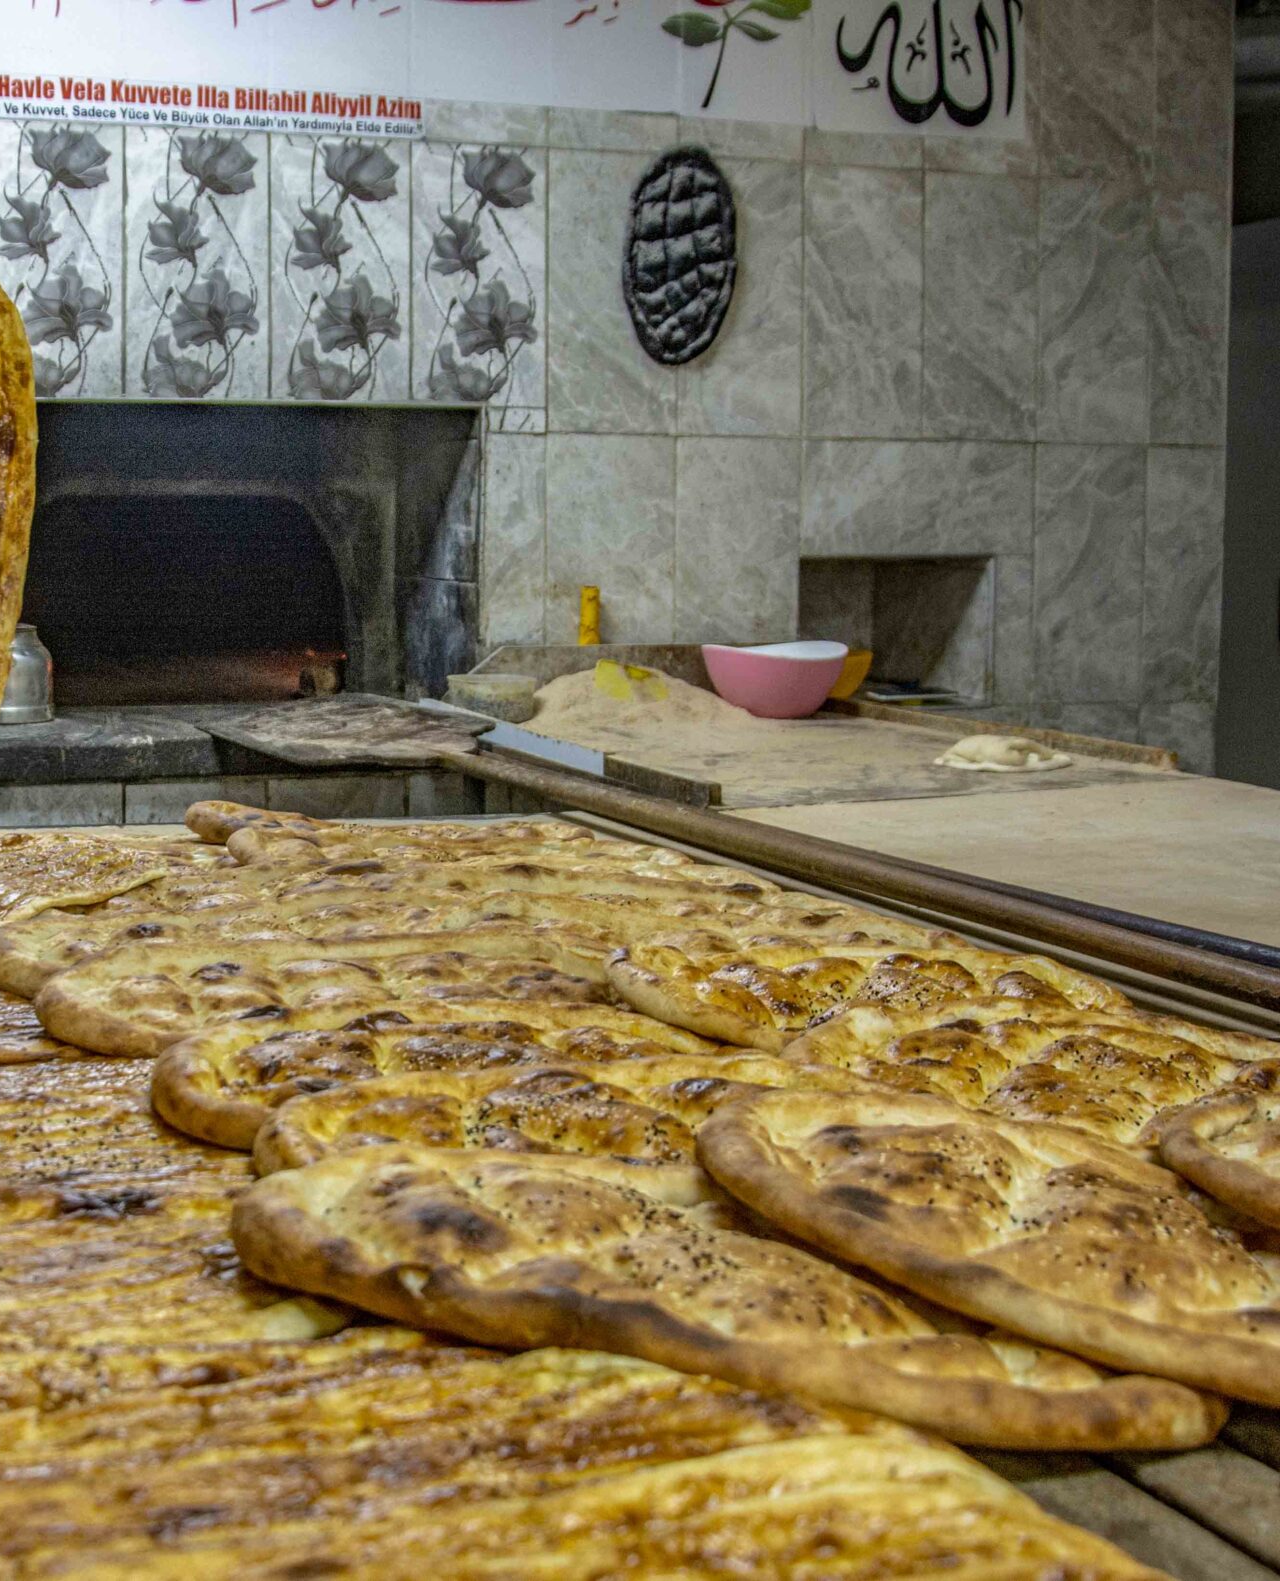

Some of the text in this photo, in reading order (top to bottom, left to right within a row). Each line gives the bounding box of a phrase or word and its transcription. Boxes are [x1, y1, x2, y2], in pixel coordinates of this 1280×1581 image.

[59, 77, 106, 101] Vela
[111, 80, 192, 106] Kuvvete
[234, 87, 307, 113] Billahil
[311, 91, 372, 118] Aliyyil
[376, 95, 422, 119] Azim
[4, 102, 19, 114] Ve
[22, 103, 69, 117] Kuvvet,
[72, 105, 116, 118] Sadece
[120, 107, 149, 120] Yüce
[153, 109, 167, 121] Ve
[172, 111, 209, 124] Büyük
[213, 113, 240, 125] Olan
[291, 117, 352, 133] Yardımıyla
[356, 121, 381, 132] Elde
